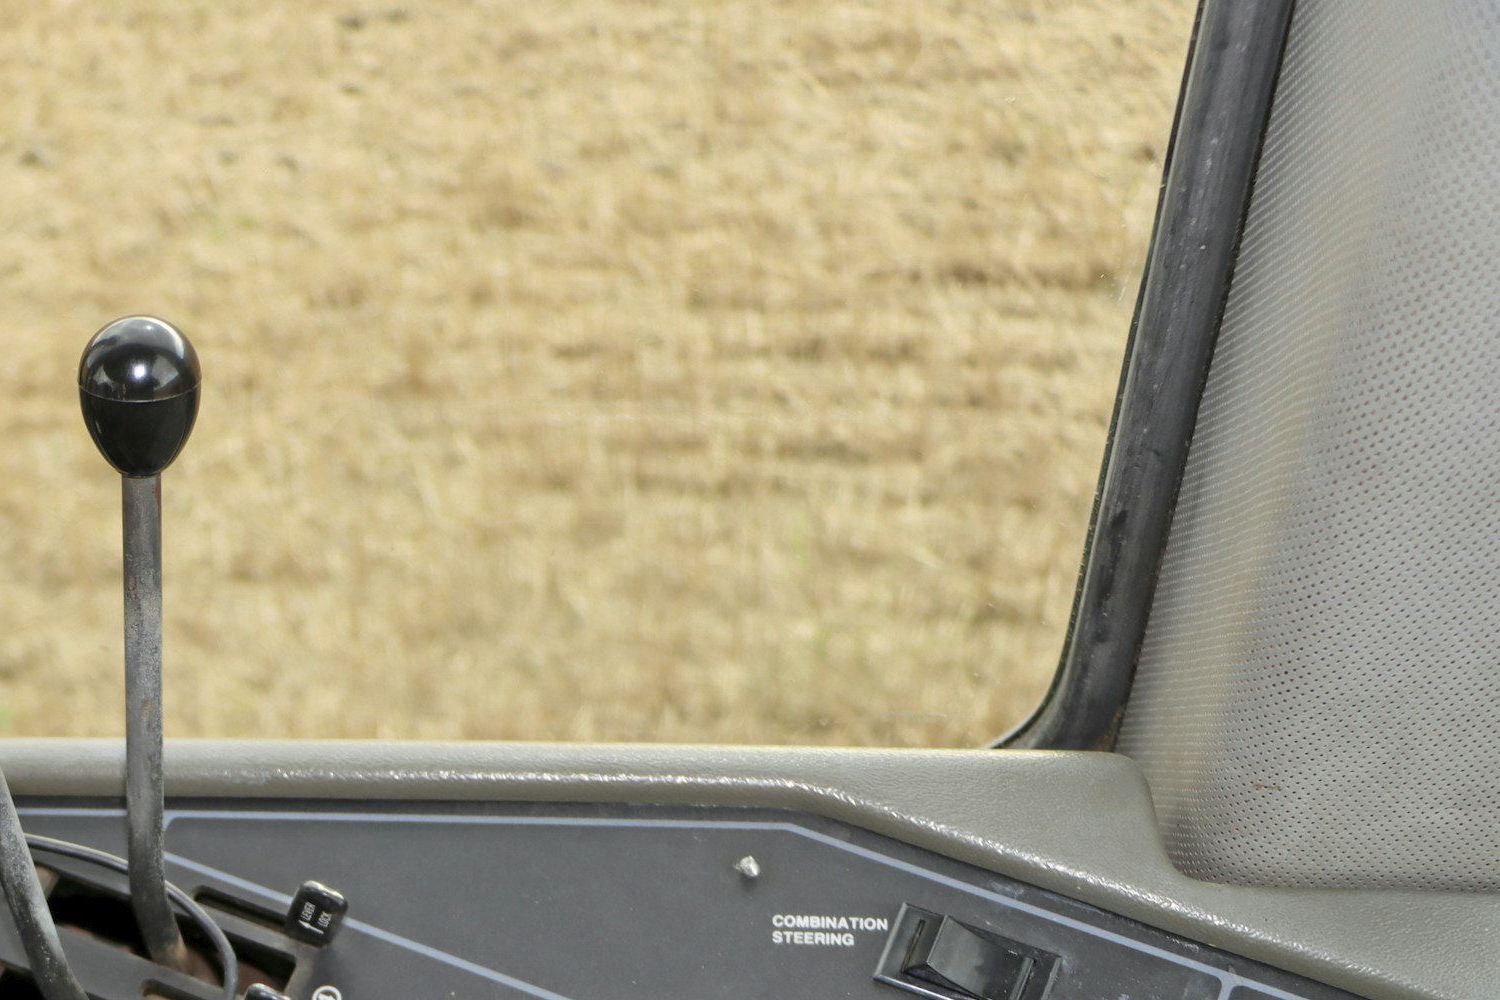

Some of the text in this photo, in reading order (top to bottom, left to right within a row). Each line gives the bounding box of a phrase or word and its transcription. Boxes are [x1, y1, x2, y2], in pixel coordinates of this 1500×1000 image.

[300, 902, 316, 921] LEVER
[318, 911, 333, 928] LOCK
[772, 914, 888, 932] COMBINATION
[772, 930, 854, 946] STEERING
